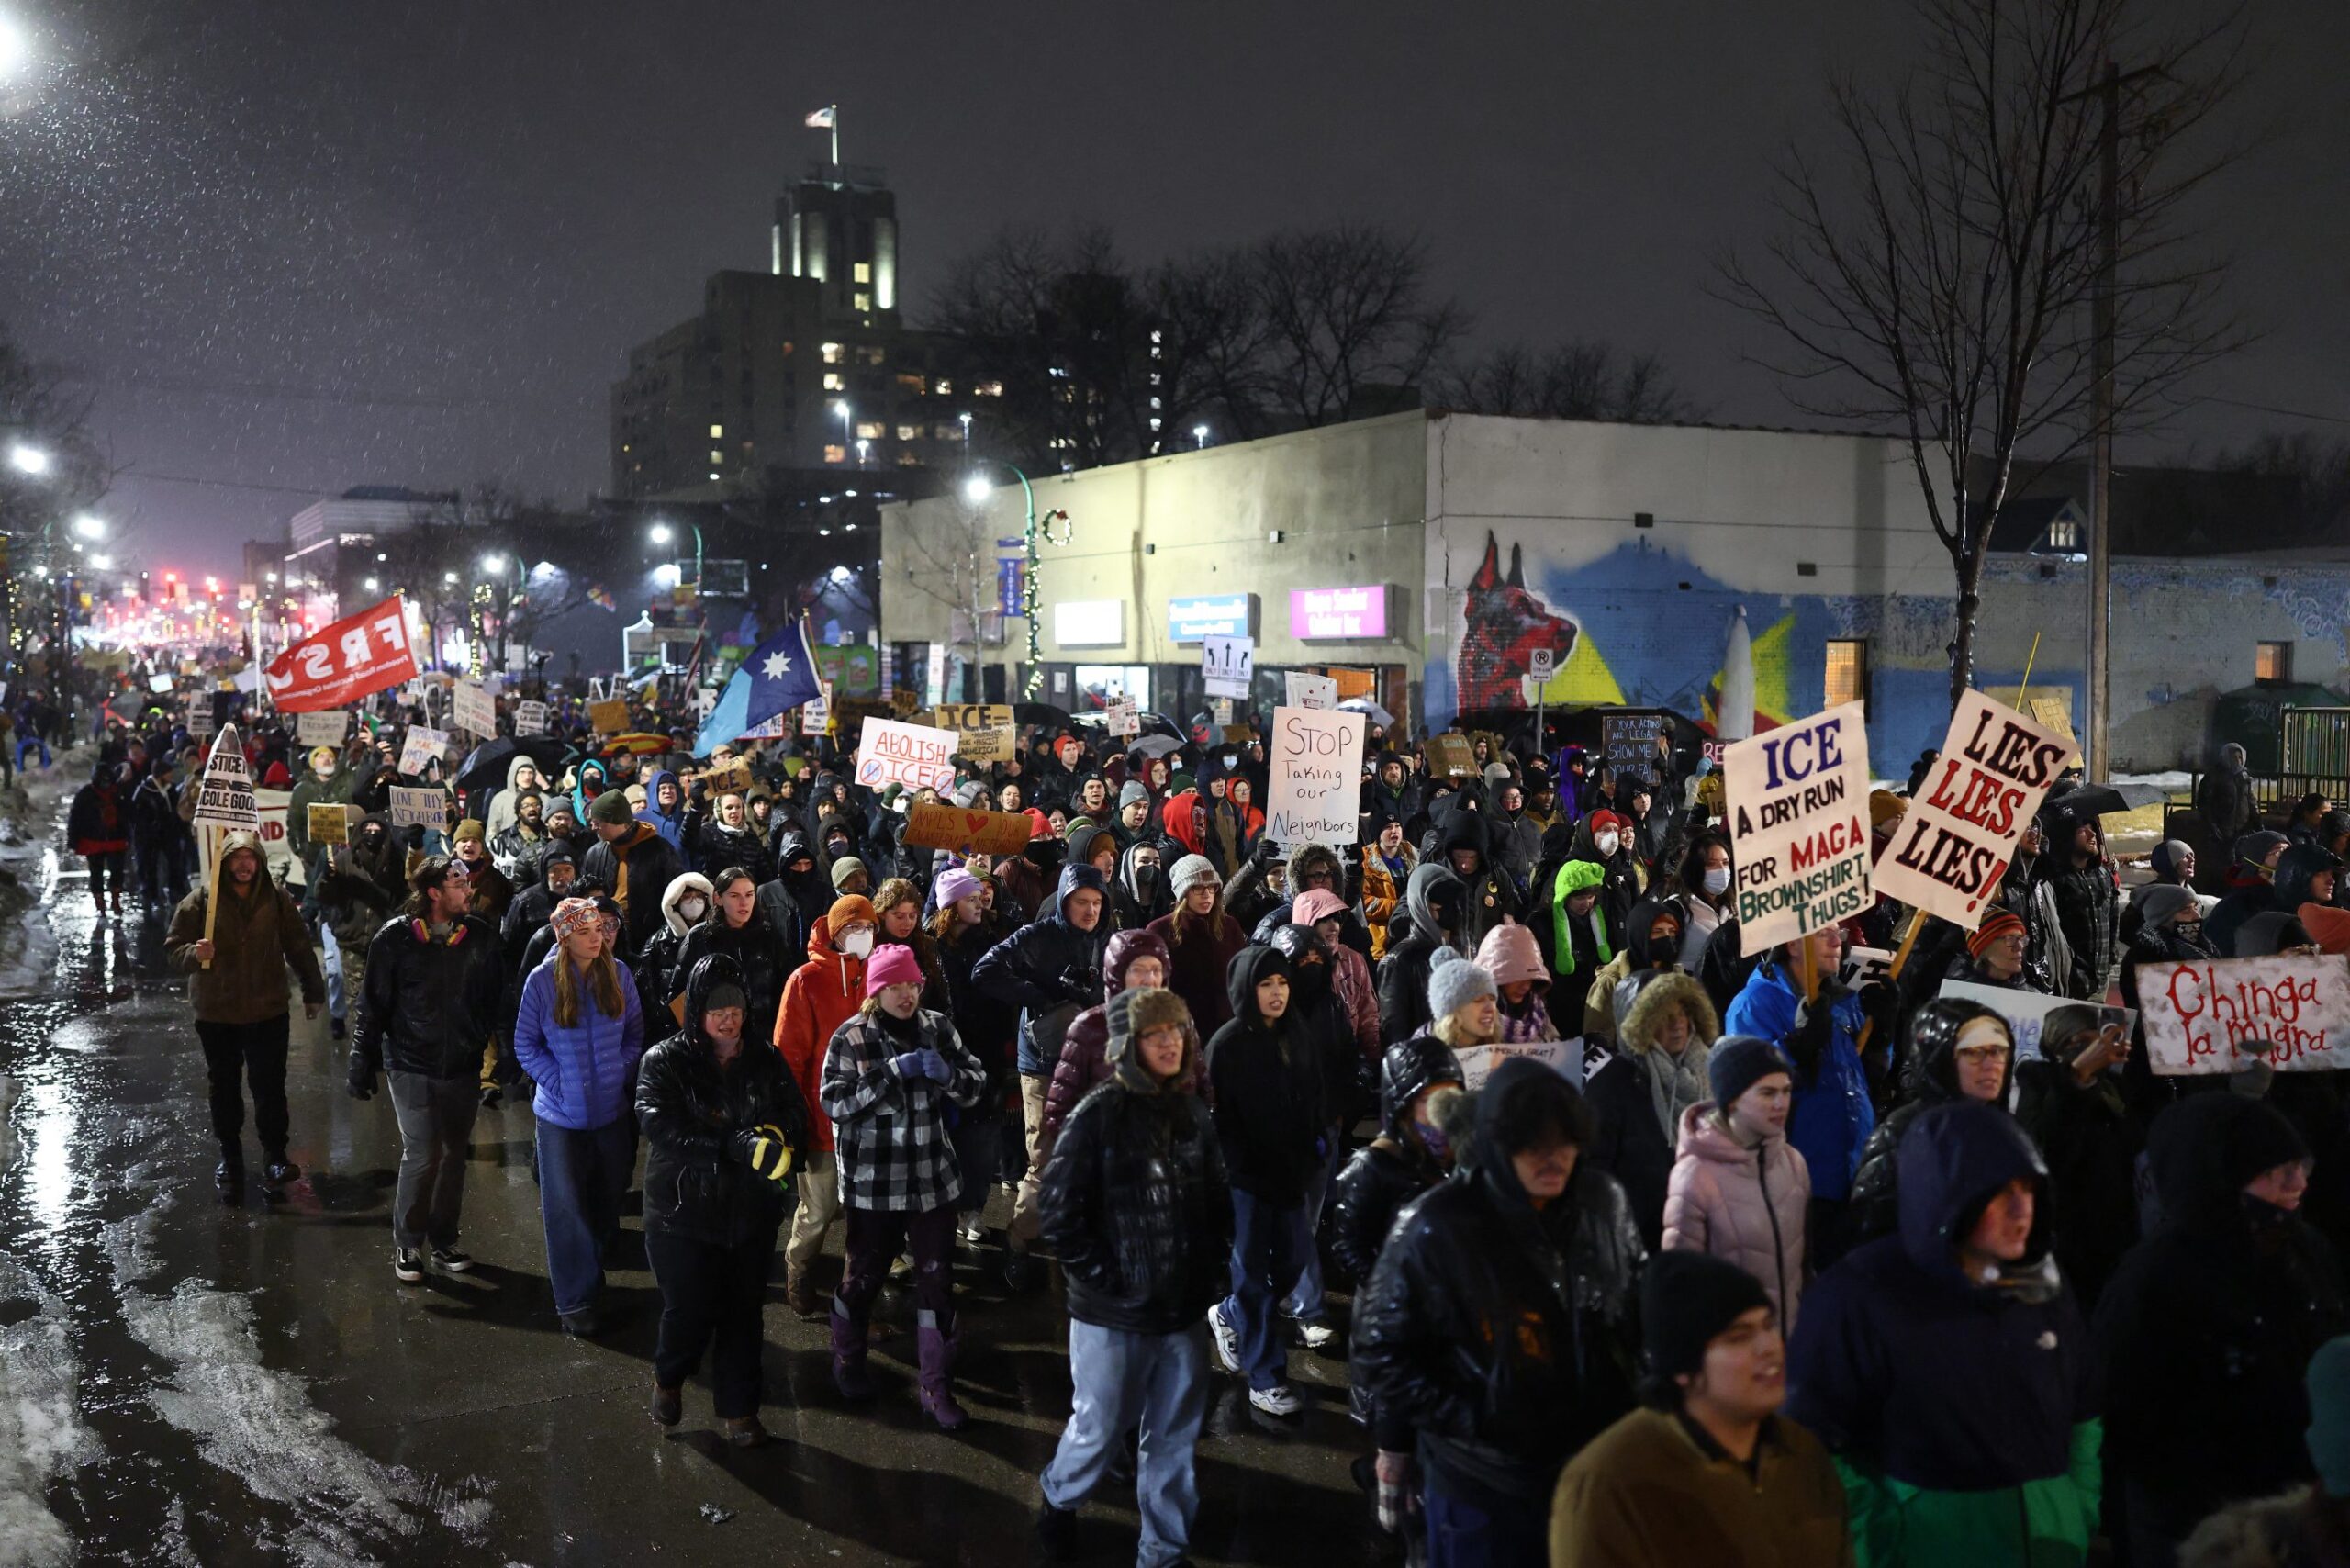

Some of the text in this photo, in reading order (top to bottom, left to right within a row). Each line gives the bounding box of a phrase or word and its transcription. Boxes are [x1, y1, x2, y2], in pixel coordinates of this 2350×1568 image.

[1007, 561, 1015, 614] MIDTOWN
[1284, 717, 1352, 757] STOP
[1617, 719, 1637, 731] YOUR
[875, 732, 946, 766] ABOLISH
[1608, 742, 1651, 760] SHOW ME
[1762, 717, 1843, 790] ICE
[1964, 708, 2066, 790] LIES,
[1281, 759, 1343, 790] Taking
[1297, 788, 1327, 800] our
[391, 790, 445, 809] LOVE THY
[394, 807, 446, 824] NEIGHBOR
[1737, 775, 1845, 839] A DRY RUN
[1926, 758, 2026, 840] LIES,
[915, 810, 955, 831] MPLS
[1271, 810, 1355, 840] Neighbors
[1738, 815, 1864, 892] FOR MAGA
[1895, 818, 2009, 913] LIES!
[2166, 964, 2322, 1024] Chinga
[2181, 1017, 2333, 1066] la migra
